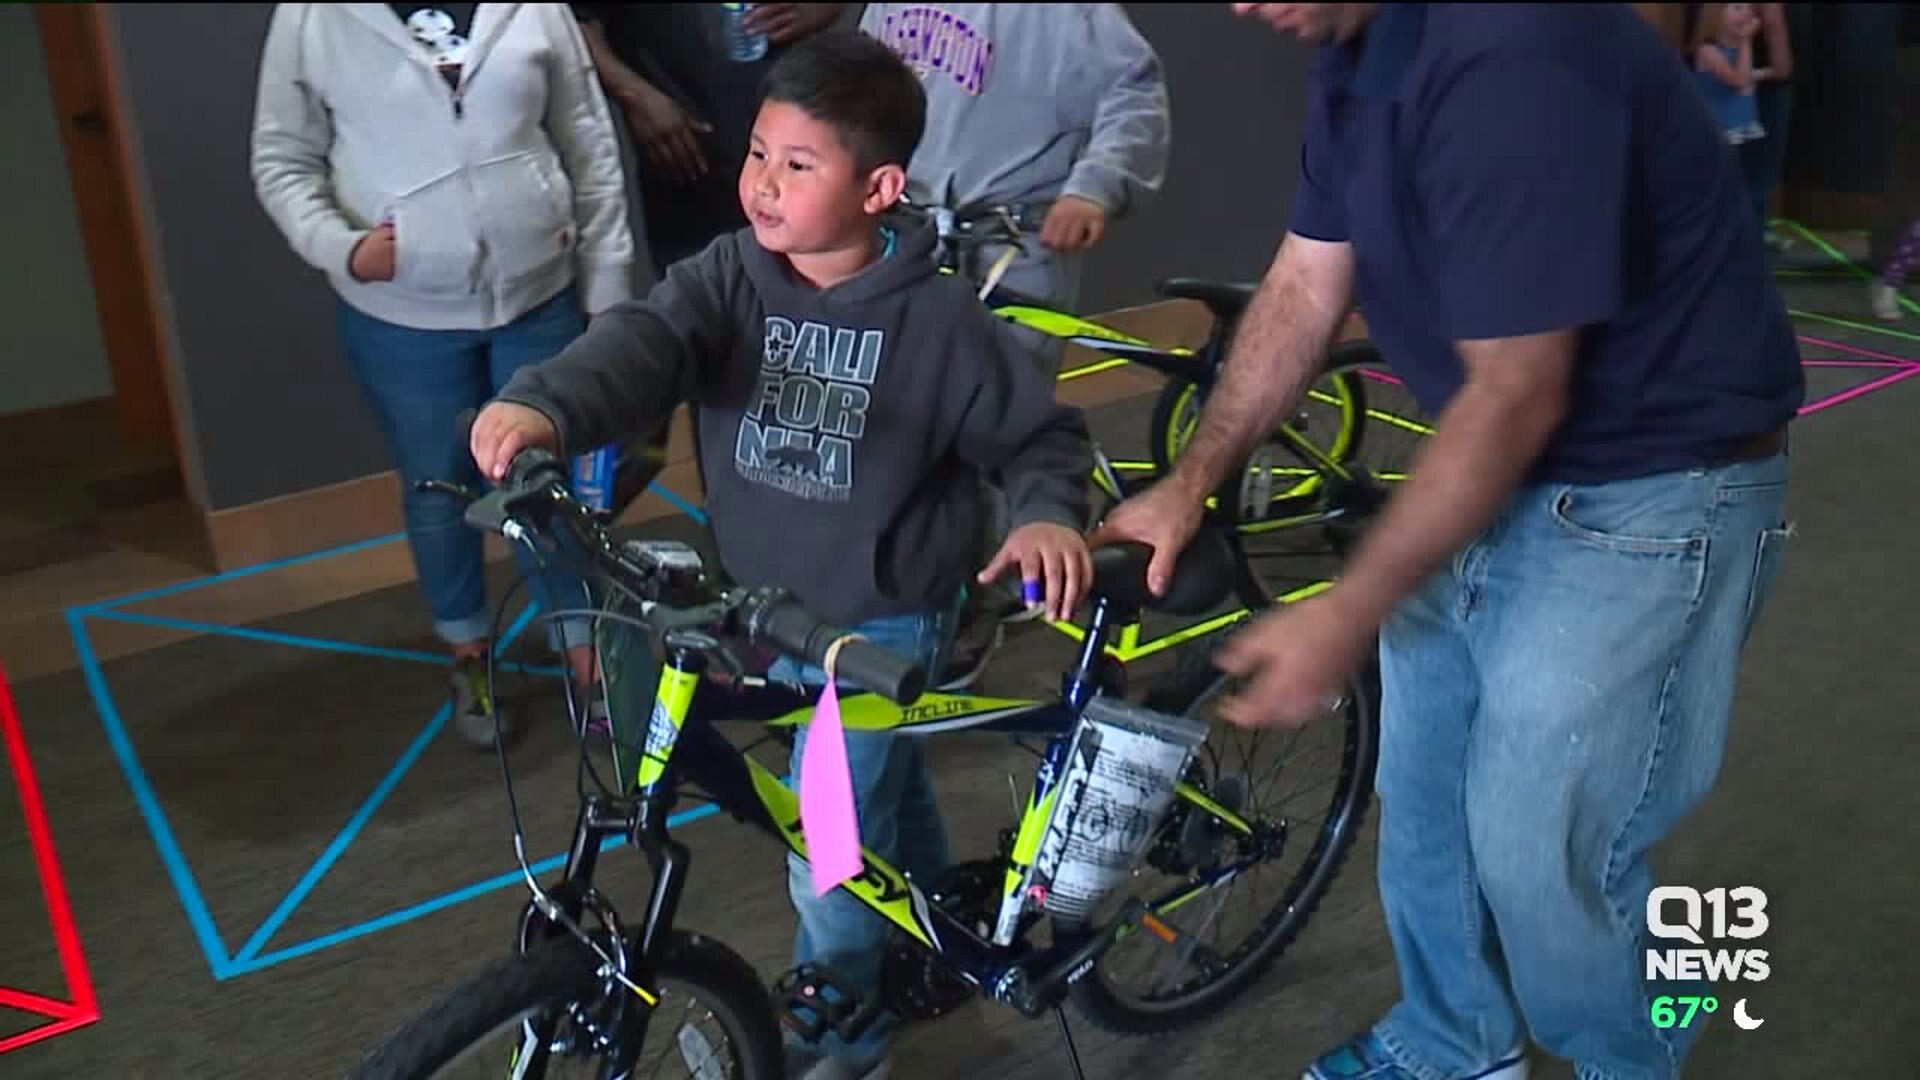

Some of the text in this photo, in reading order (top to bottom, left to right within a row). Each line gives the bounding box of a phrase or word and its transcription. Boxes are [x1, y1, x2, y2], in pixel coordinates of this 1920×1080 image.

[761, 316, 884, 384] CALI
[745, 369, 871, 439] FOR
[1037, 747, 1090, 882] HUFFY
